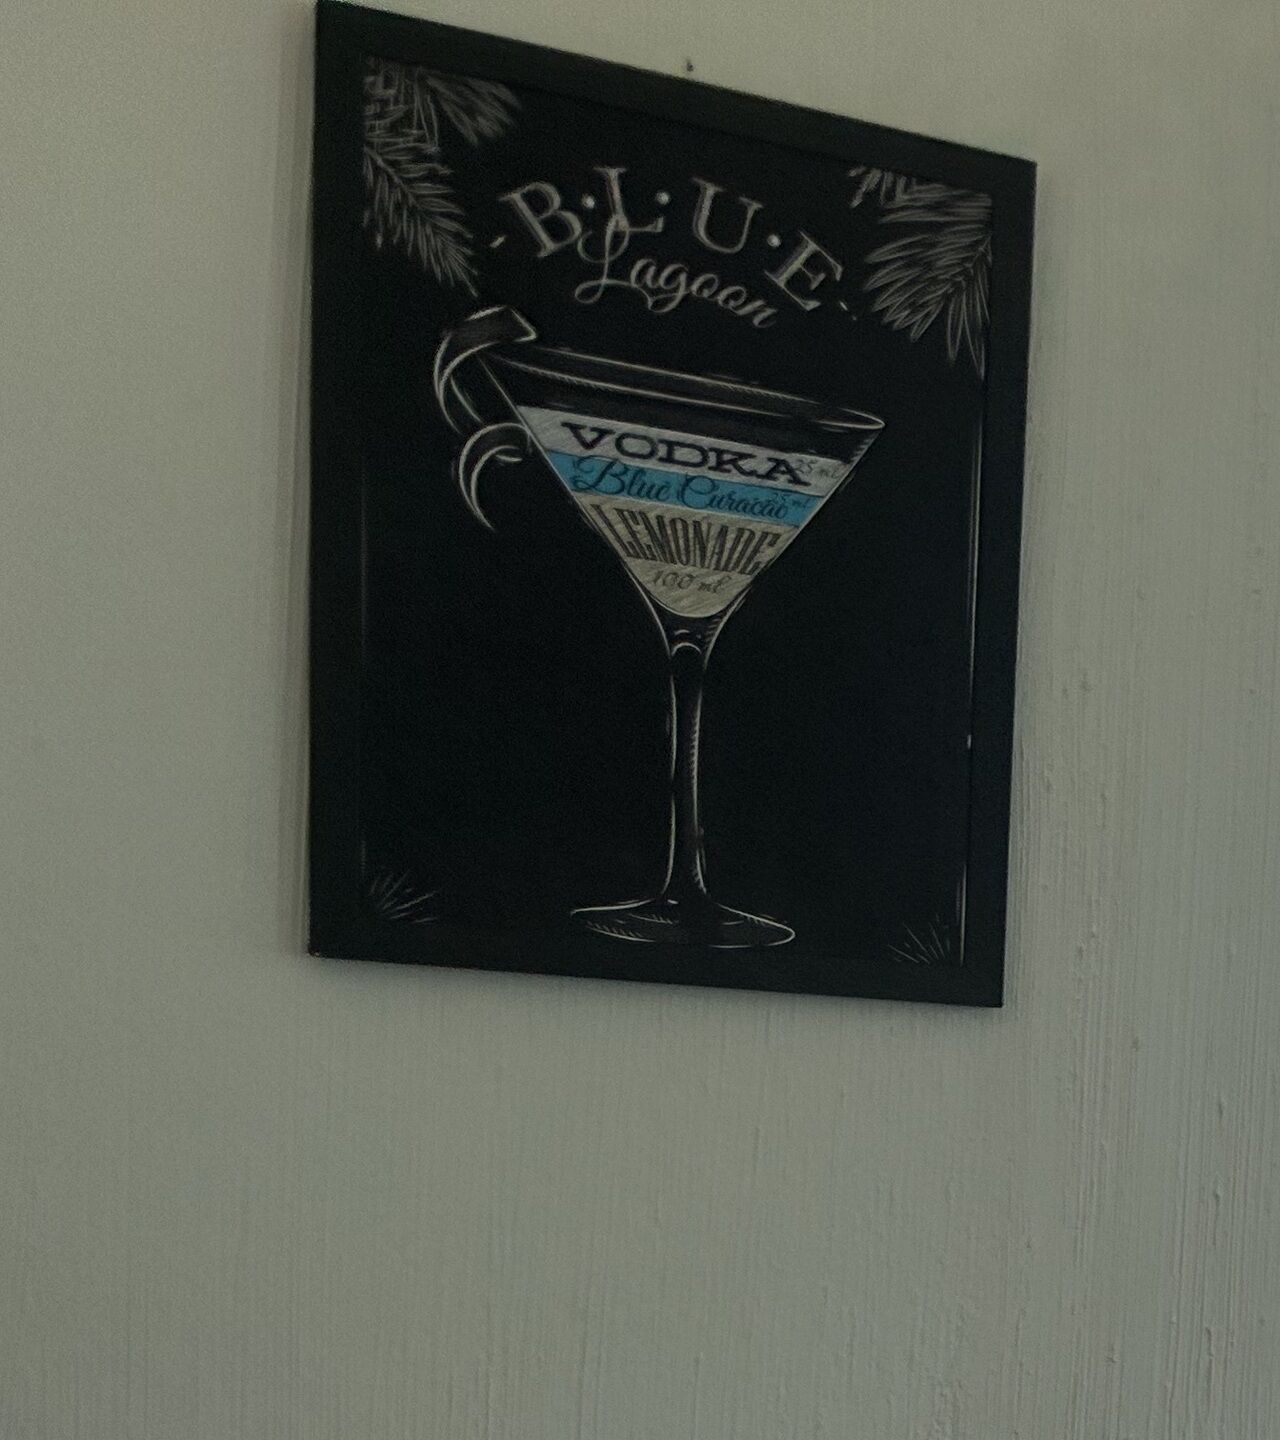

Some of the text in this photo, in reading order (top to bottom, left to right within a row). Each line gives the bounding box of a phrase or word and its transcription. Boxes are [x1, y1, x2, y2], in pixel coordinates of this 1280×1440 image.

[575, 214, 778, 329] Lagoon
[561, 421, 812, 487] VODKA
[572, 455, 672, 502] Blue
[590, 504, 783, 577] LEMONADE
